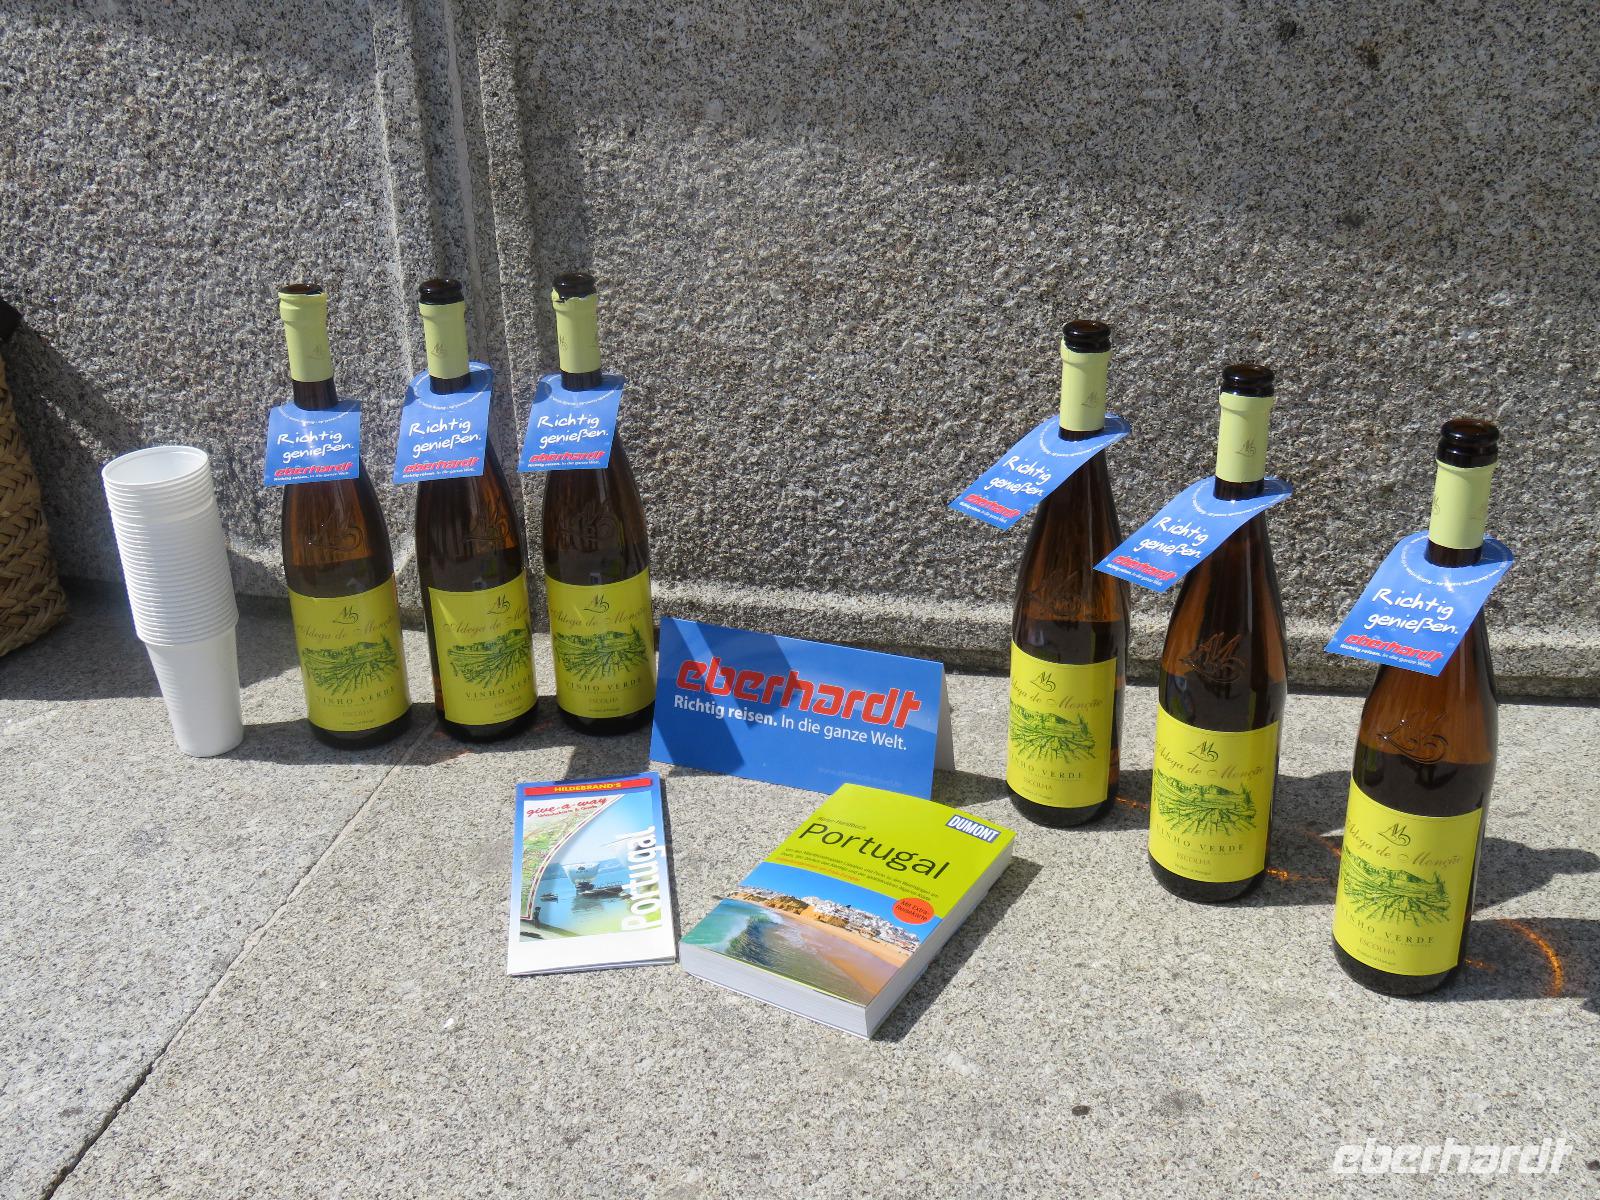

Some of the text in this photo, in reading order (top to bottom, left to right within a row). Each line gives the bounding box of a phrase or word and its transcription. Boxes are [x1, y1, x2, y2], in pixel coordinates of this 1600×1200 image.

[409, 418, 471, 436] Richtig
[537, 413, 600, 429] Richtig
[277, 431, 342, 445] Richtig
[413, 433, 481, 459] genießen.
[539, 428, 609, 450] genießen.
[282, 443, 354, 464] genießen.
[1002, 455, 1052, 486] Richtig
[983, 477, 1043, 497] genießen.
[1152, 516, 1209, 547] Richtig
[1133, 538, 1201, 559] genießen.
[1372, 588, 1454, 621] Richtig
[1363, 613, 1459, 634] genießen.
[1343, 634, 1444, 662] eberhardt
[676, 656, 922, 730] eberhardt
[673, 694, 908, 751] Richtig reisen. In die ganze Welt.
[554, 782, 622, 793] HILDEBRAND'S
[947, 815, 999, 842] DUMONT
[798, 823, 950, 880] Portugal
[1199, 844, 1244, 853] VERDE
[616, 825, 662, 931] Portugal
[1384, 931, 1435, 944] VERDE
